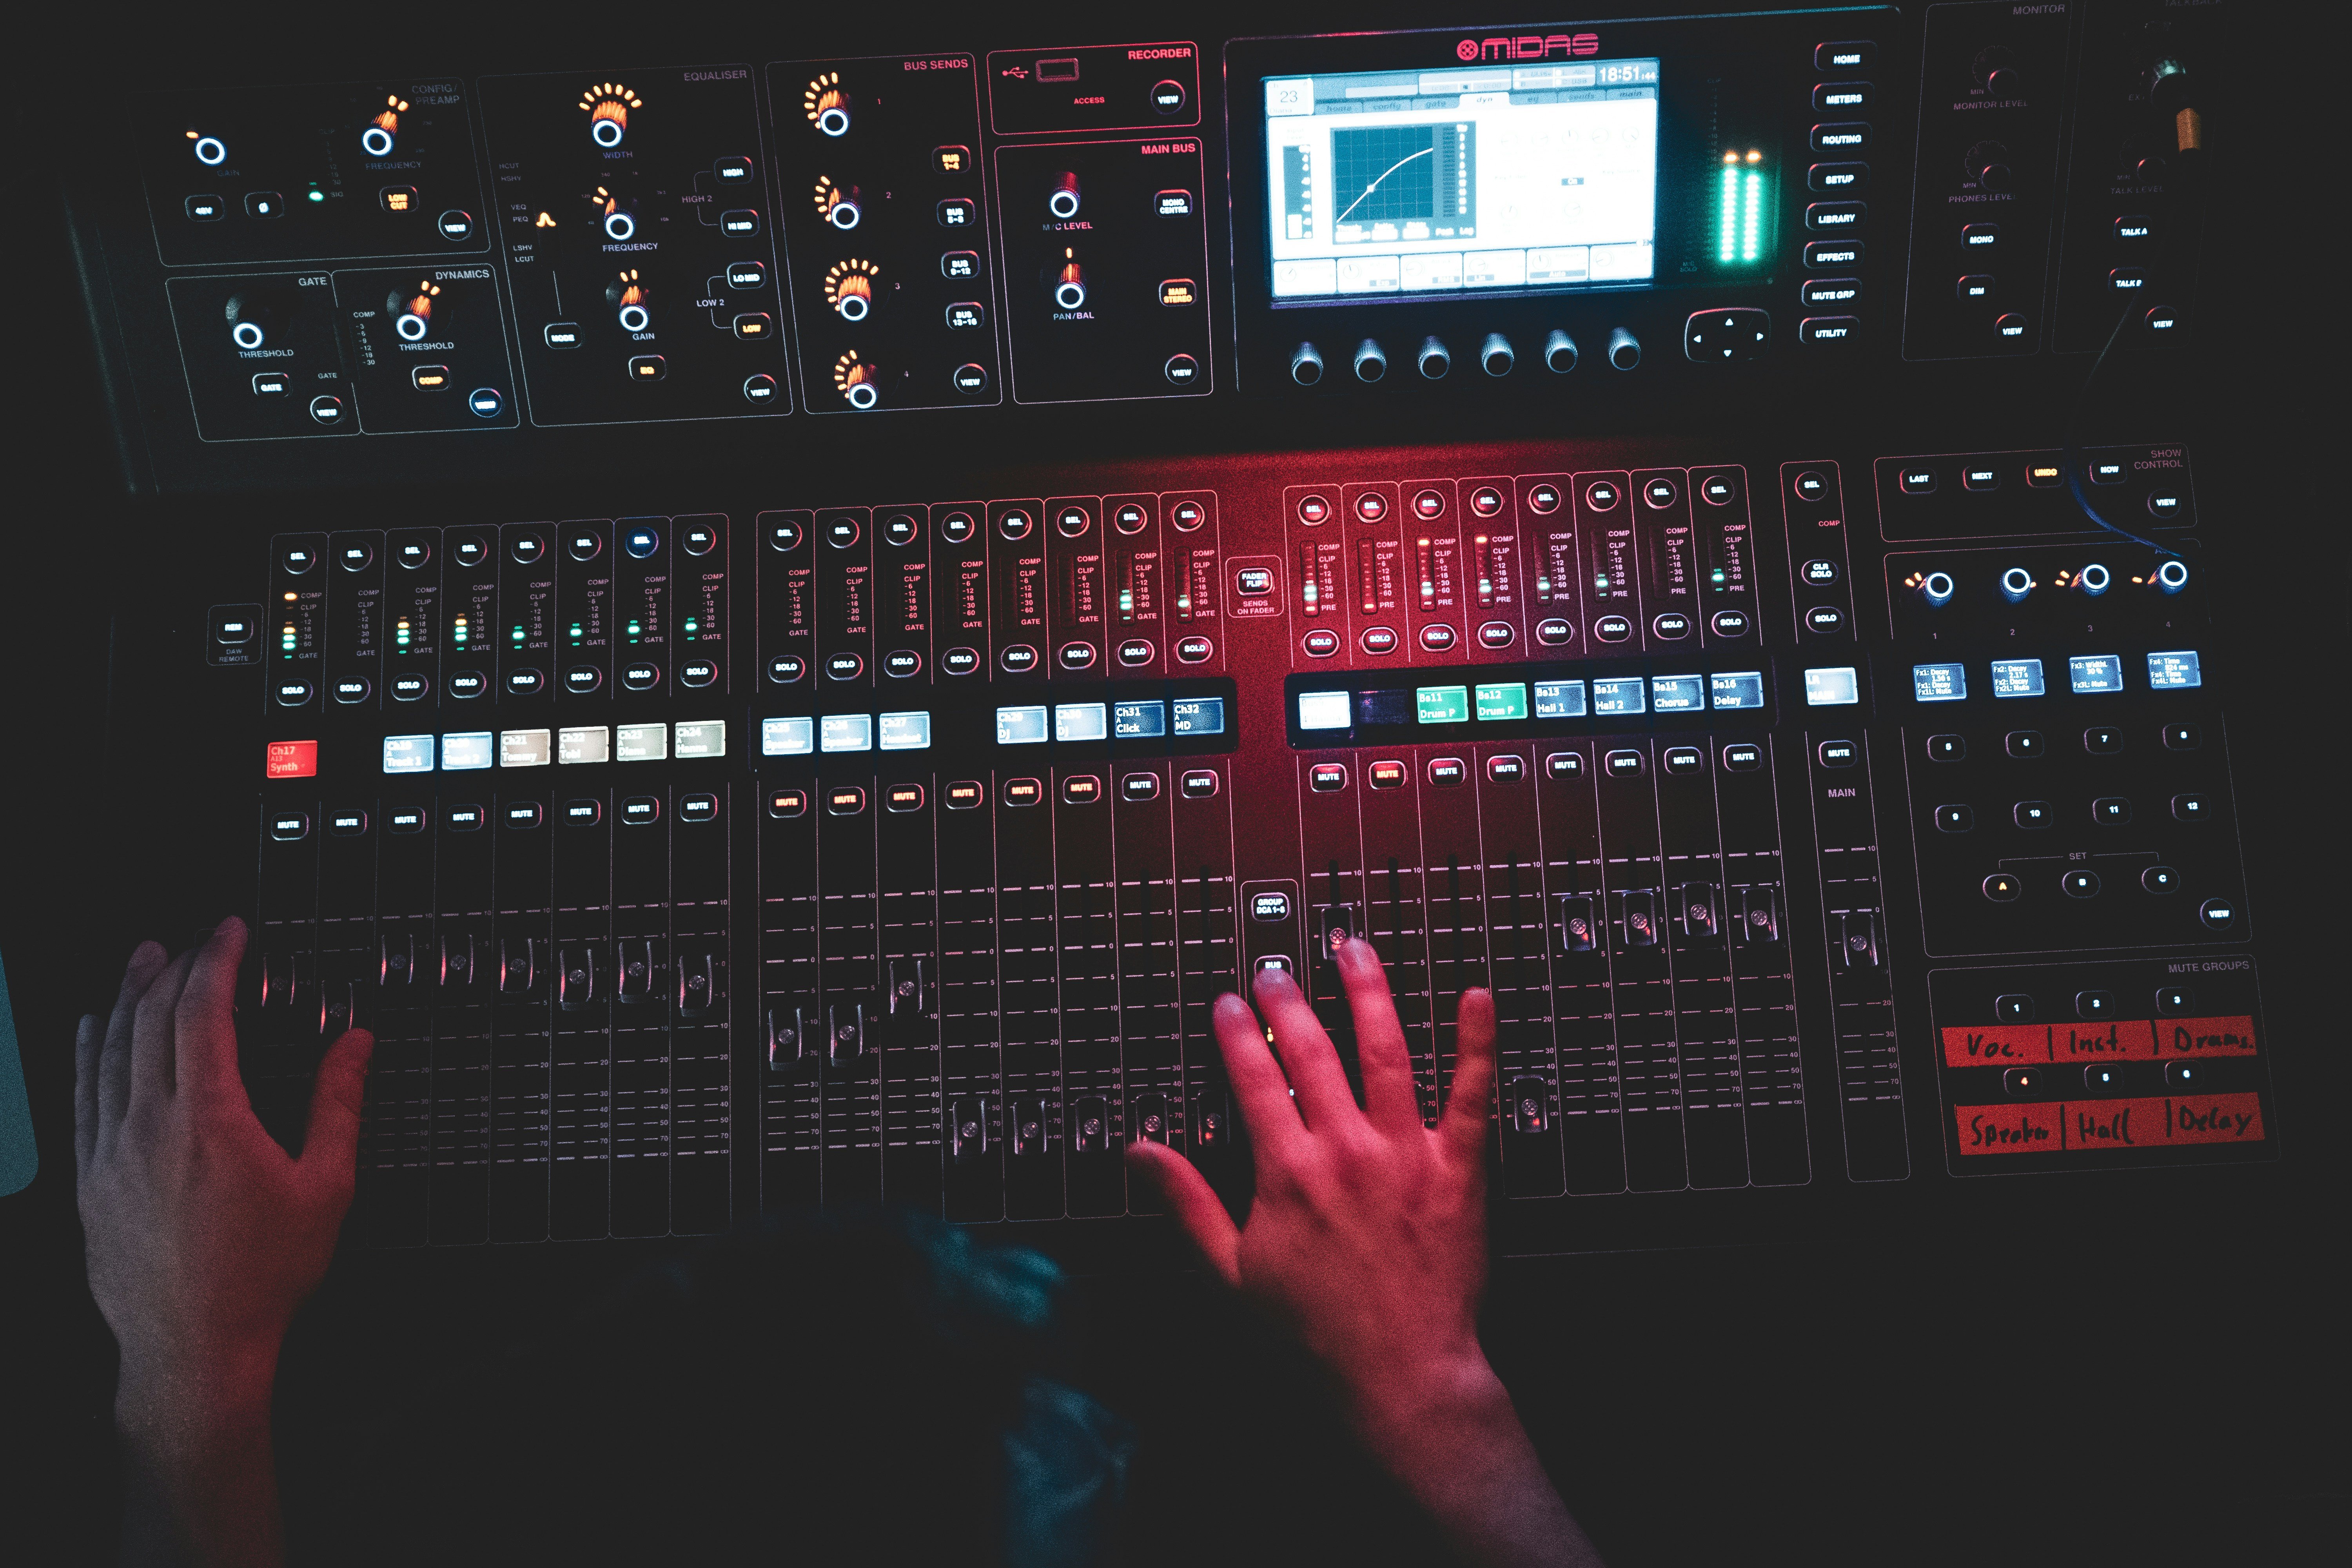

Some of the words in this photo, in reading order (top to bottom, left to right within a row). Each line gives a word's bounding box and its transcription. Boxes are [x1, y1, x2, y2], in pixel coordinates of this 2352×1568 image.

[2013, 4, 2065, 15] MONITOR
[1481, 33, 1599, 60] MIDAS
[1128, 48, 1191, 60] RECORDER
[1834, 55, 1860, 65] HOME
[904, 62, 927, 71] BUS
[930, 59, 968, 69] SENDS
[684, 71, 747, 82] EQUALISER
[415, 95, 460, 105] PREAMP
[1158, 95, 1178, 104] VIEW
[1280, 91, 1298, 103] 23
[1826, 94, 1862, 104] METERS
[1954, 101, 1997, 110] MONITOR
[2000, 100, 2028, 108] LEVEL
[1822, 135, 1862, 144] ROUTING
[1142, 145, 1169, 154] MAIN
[1172, 143, 1196, 153] BUS
[942, 154, 960, 162] BUS
[366, 162, 421, 170] FREQUENCY
[723, 169, 743, 177] HIGH
[1825, 174, 1854, 184] SETUP
[2136, 185, 2163, 194] LEVEL
[1949, 194, 1987, 203] PHONES
[1818, 214, 1855, 224] LIBRARY
[2121, 228, 2140, 236] TALK
[1969, 235, 1994, 244] MONO
[603, 243, 658, 252] FREQUENCY
[1817, 252, 1855, 262] EFFECTS
[436, 270, 489, 280] DYNAMICS
[298, 277, 327, 287] GATE
[2116, 279, 2135, 288] TALK
[1168, 287, 1187, 296] MAIN
[1812, 291, 1835, 300] MUTE
[1837, 290, 1855, 299] GRP
[1163, 295, 1192, 303] STEREO
[1053, 312, 1094, 320] PAN/BAL
[953, 318, 977, 326] 13-16
[2153, 320, 2173, 328] VIEW
[1815, 329, 1847, 338] UTILITY
[2002, 327, 2022, 336] VIEW
[399, 342, 454, 351] THRESHOLD
[239, 350, 293, 358] THRESHOLD
[419, 376, 443, 385] COMP
[960, 378, 980, 387] VIEW
[2151, 449, 2182, 458] SHOW
[2134, 460, 2183, 470] CONTROL
[1972, 472, 1993, 480] NEXT
[2034, 468, 2057, 477] UNDO
[2156, 498, 2176, 506] VIEW
[1181, 510, 1196, 518] SEL
[1811, 570, 1832, 578] SOLO
[950, 655, 972, 663] SOLO
[1655, 699, 1689, 708] Chorus
[1714, 696, 1741, 706] Delay
[1116, 708, 1141, 717] Ch31
[1174, 704, 1199, 714] Ch32
[1537, 704, 1556, 713] Hall
[1559, 703, 1565, 711] 1
[1420, 709, 1446, 718] Drum
[1449, 708, 1455, 717] P
[1116, 724, 1140, 733] Click
[1175, 721, 1191, 730] MD
[271, 746, 295, 755] Ch17
[271, 763, 298, 773] Synth
[893, 792, 916, 801] MUTE
[1828, 788, 1856, 798] MAIN
[2187, 802, 2198, 810] 12
[2030, 809, 2040, 817] 10
[2069, 852, 2087, 860] SET
[2158, 874, 2167, 882] C
[1999, 882, 2007, 890] A
[2168, 963, 2199, 973] MUTE
[2203, 961, 2250, 972] GROUPS
[2014, 1004, 2020, 1012] 1
[1967, 1034, 2024, 1058] Voc.
[2079, 1108, 2134, 1145] Hall
[2180, 1105, 2252, 1136] Delay
